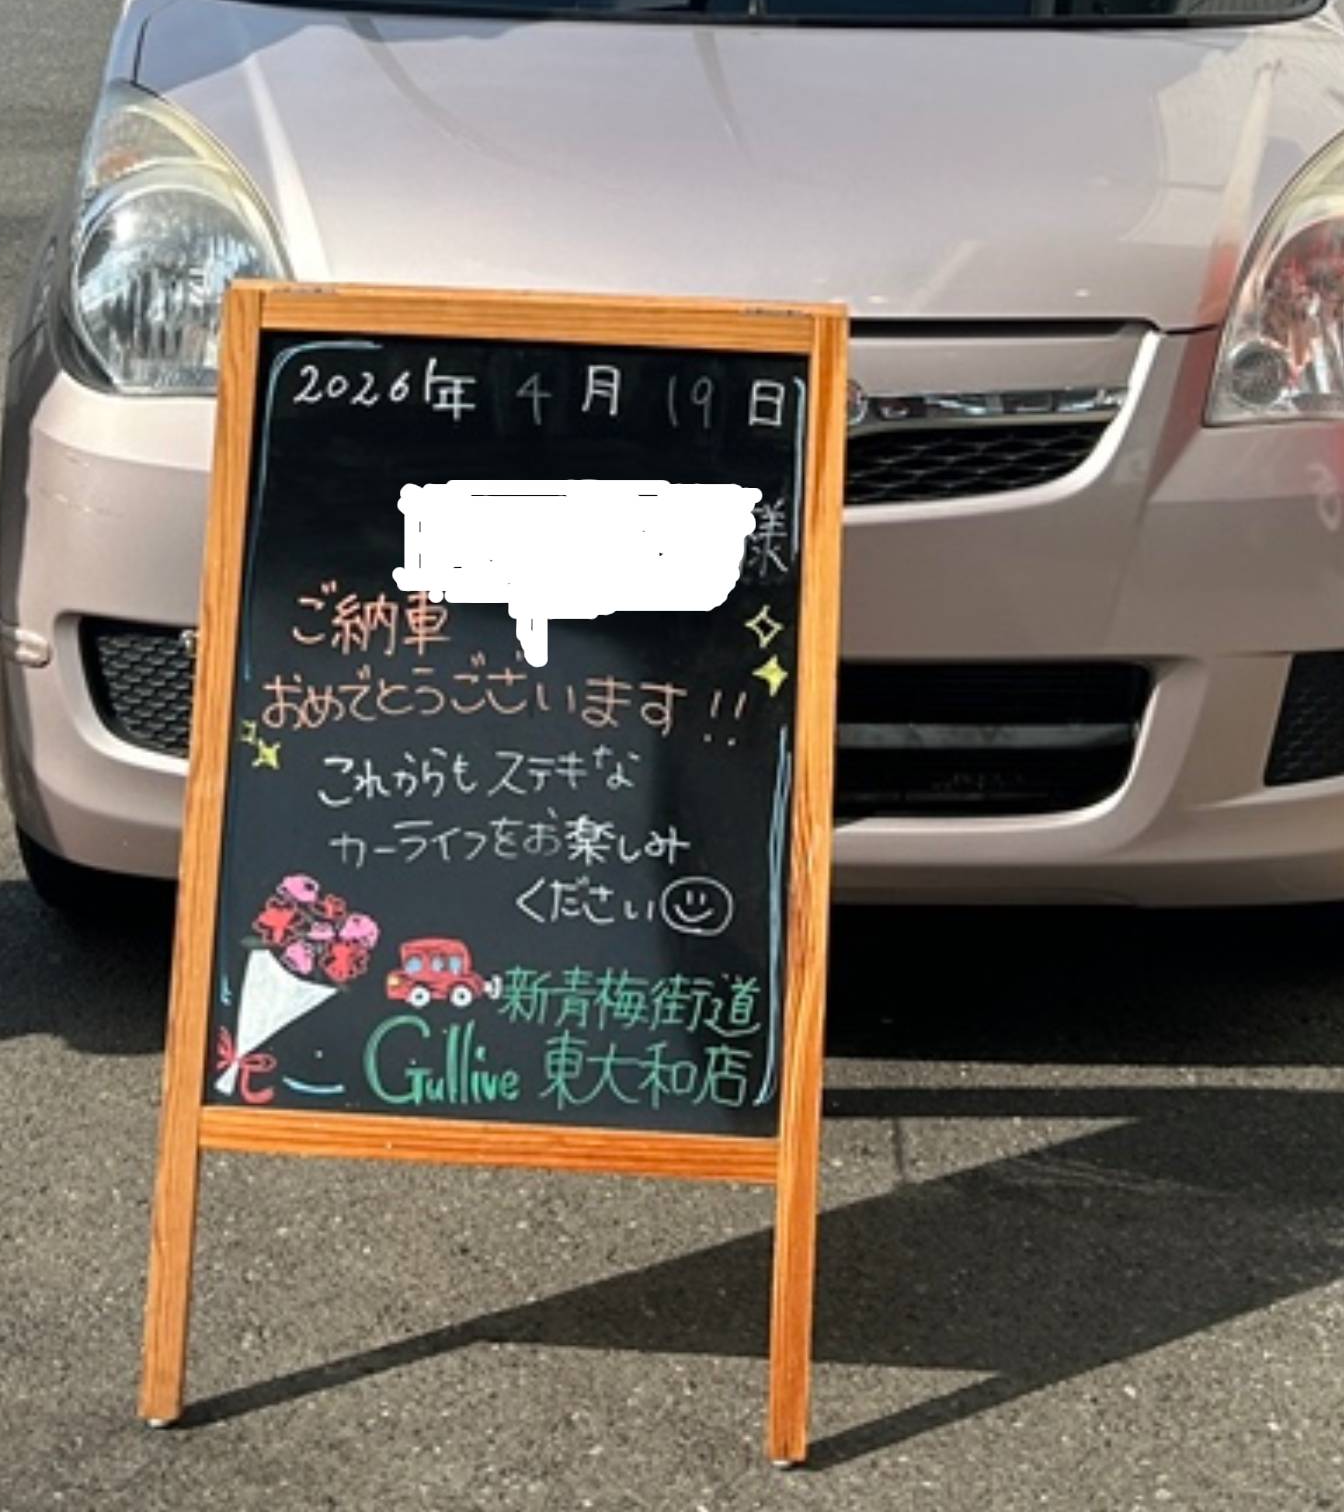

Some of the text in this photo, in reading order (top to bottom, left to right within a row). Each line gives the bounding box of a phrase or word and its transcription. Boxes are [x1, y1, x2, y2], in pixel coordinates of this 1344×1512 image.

[291, 580, 450, 656] ご納車
[317, 744, 641, 807] これからもステキな
[329, 807, 691, 868] カーライフをお楽しみ
[515, 875, 654, 924] ください
[497, 965, 761, 1038] 新青梅街道
[537, 1029, 753, 1111] 東大和店
